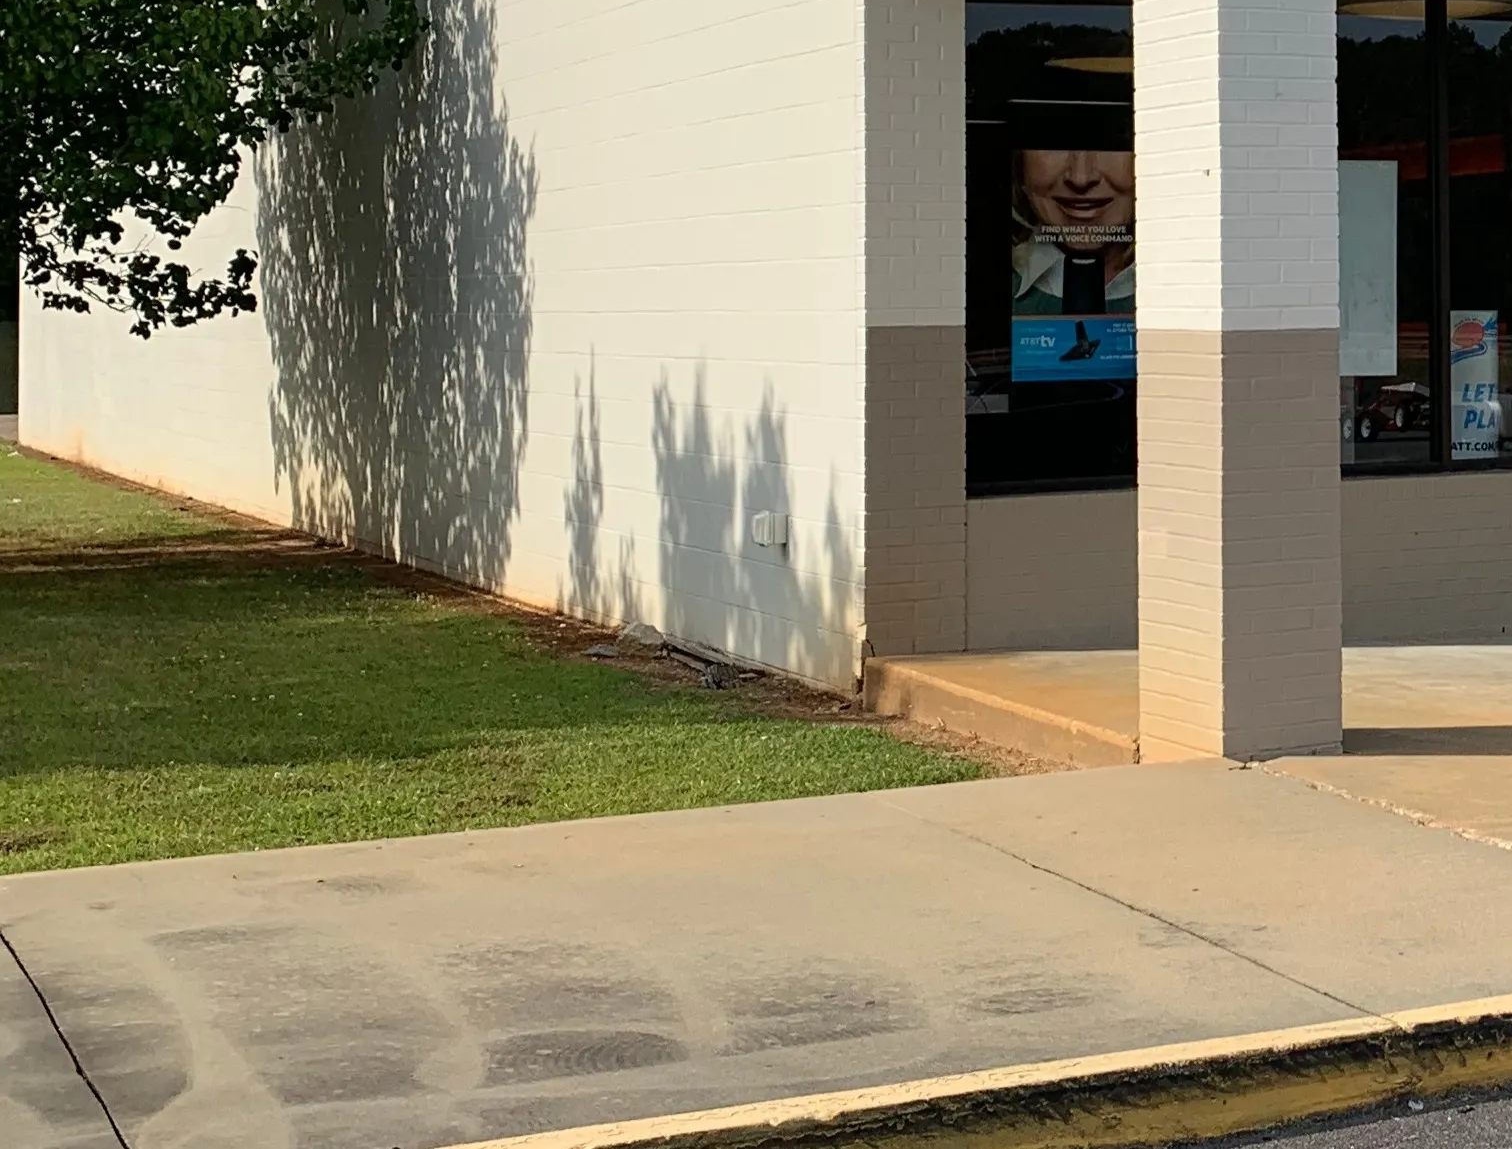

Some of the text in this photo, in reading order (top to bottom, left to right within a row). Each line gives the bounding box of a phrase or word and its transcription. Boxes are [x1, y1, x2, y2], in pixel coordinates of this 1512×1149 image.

[1041, 225, 1127, 233] FIND WHAT YOU LOVE
[1034, 235, 1134, 243] WITH A VOICE COMMAND
